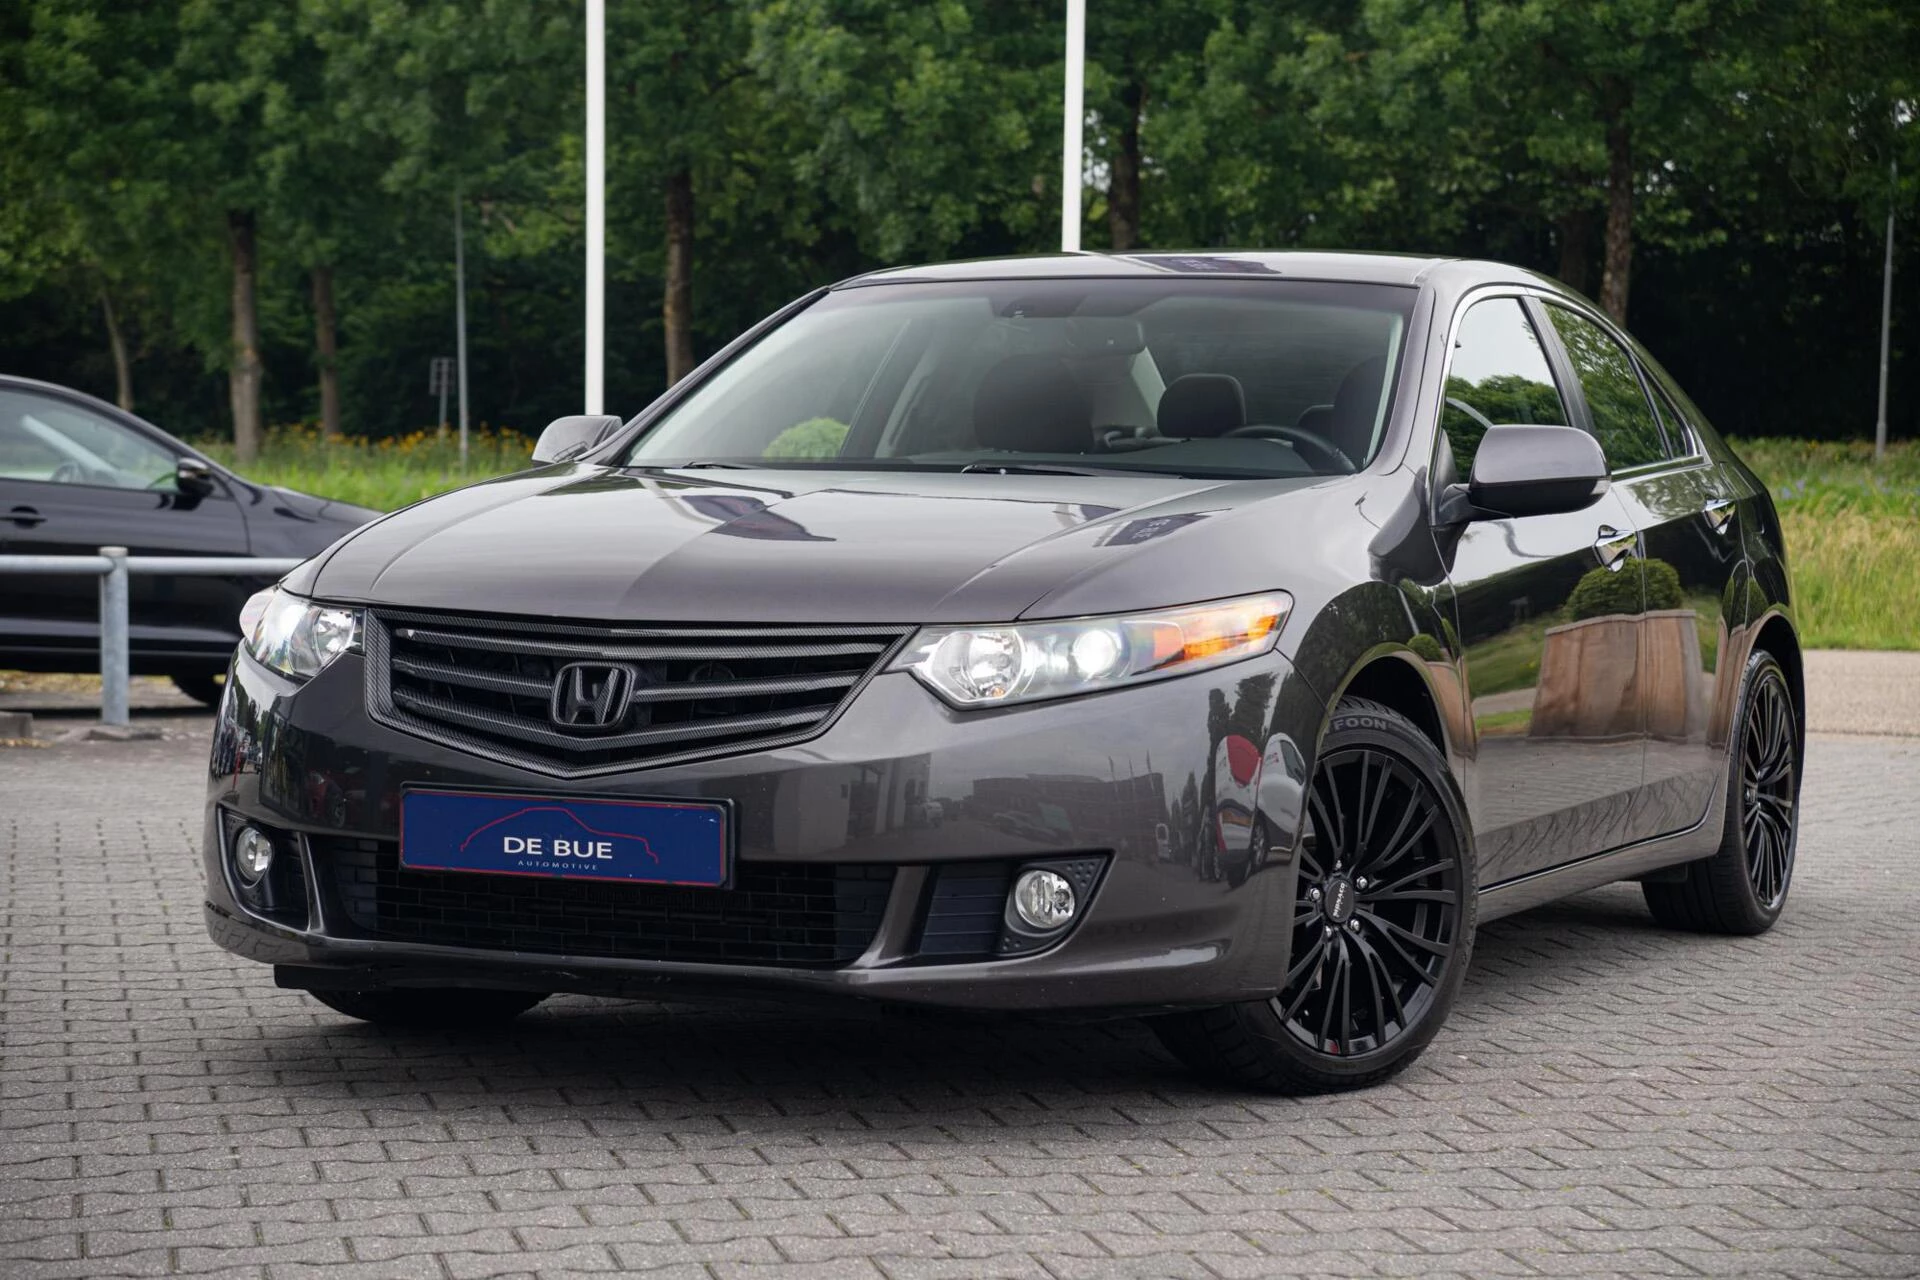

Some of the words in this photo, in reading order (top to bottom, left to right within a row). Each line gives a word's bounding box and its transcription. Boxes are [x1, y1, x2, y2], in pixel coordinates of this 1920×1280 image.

[1332, 716, 1389, 731] FOON
[503, 836, 543, 855] DE
[553, 839, 613, 860] BUE
[517, 859, 599, 871] AUTOMOTIVE
